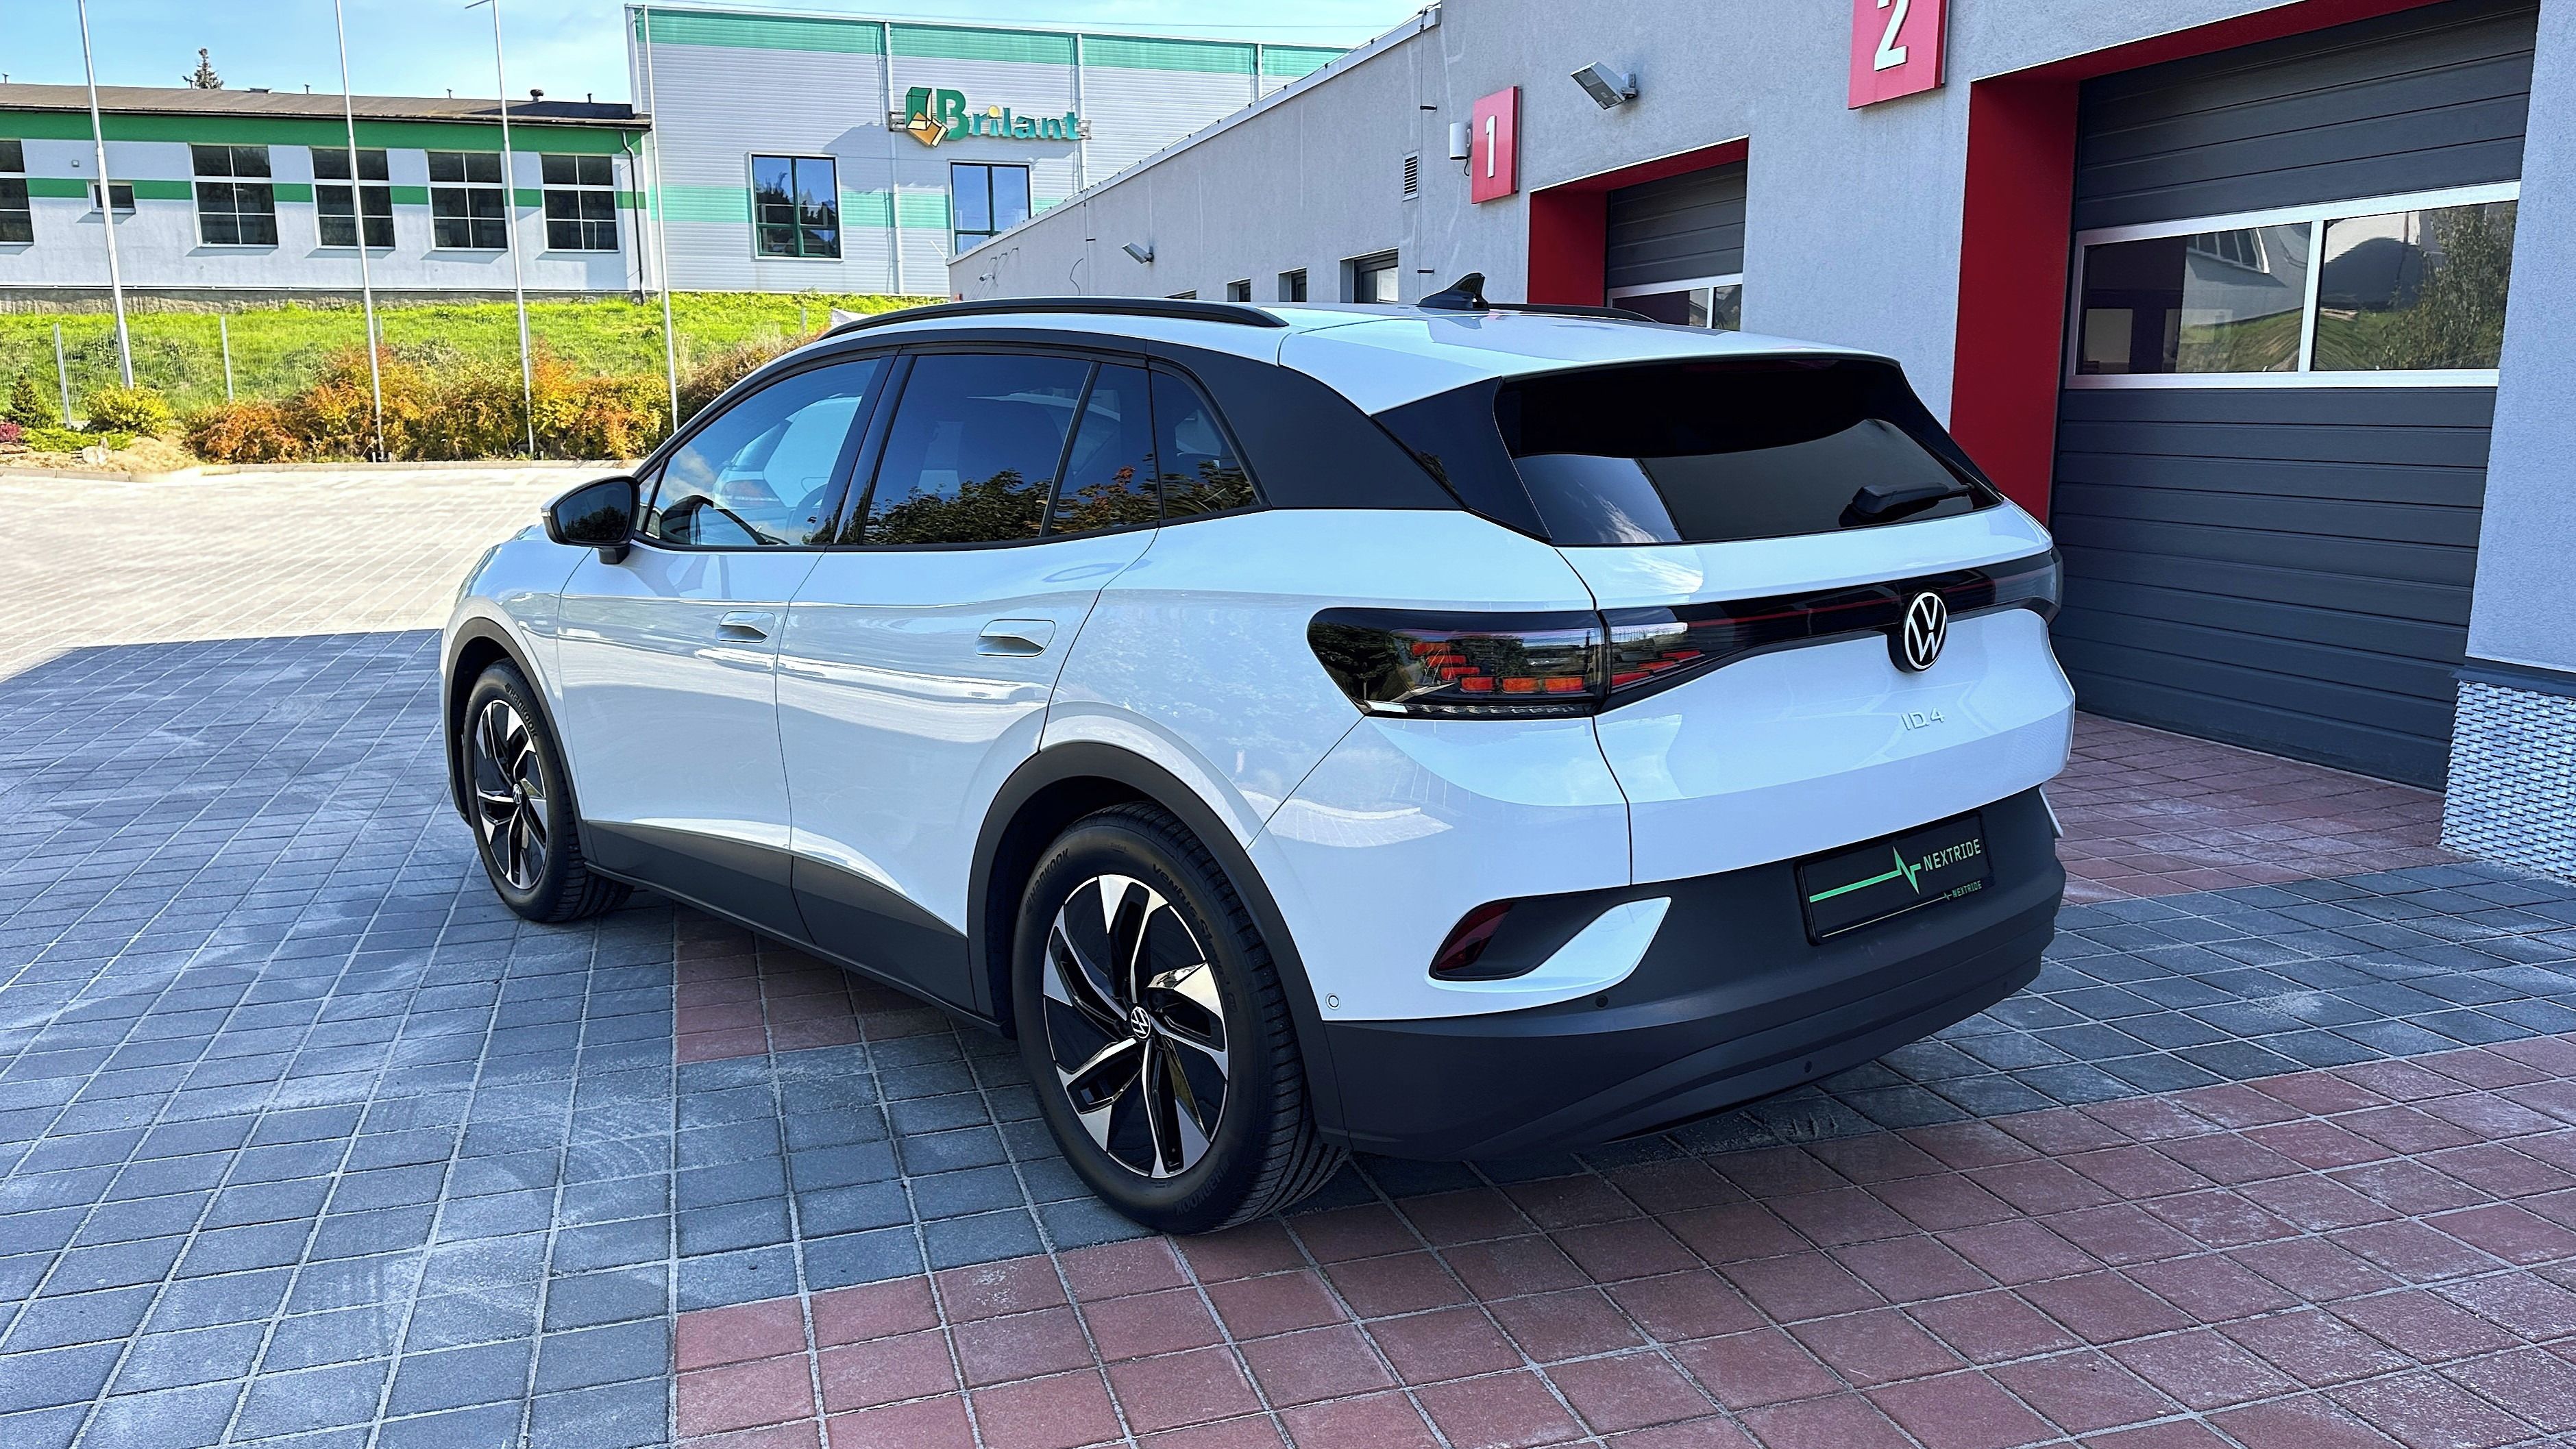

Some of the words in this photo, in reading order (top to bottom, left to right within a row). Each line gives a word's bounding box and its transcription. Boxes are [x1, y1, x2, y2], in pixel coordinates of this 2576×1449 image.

[1874, 0, 1910, 71] 2
[936, 88, 1079, 141] Brilant
[1485, 115, 1496, 177] 1
[1923, 839, 1981, 871] NEXTRIDE
[1952, 880, 1983, 898] NEXTRIDE
